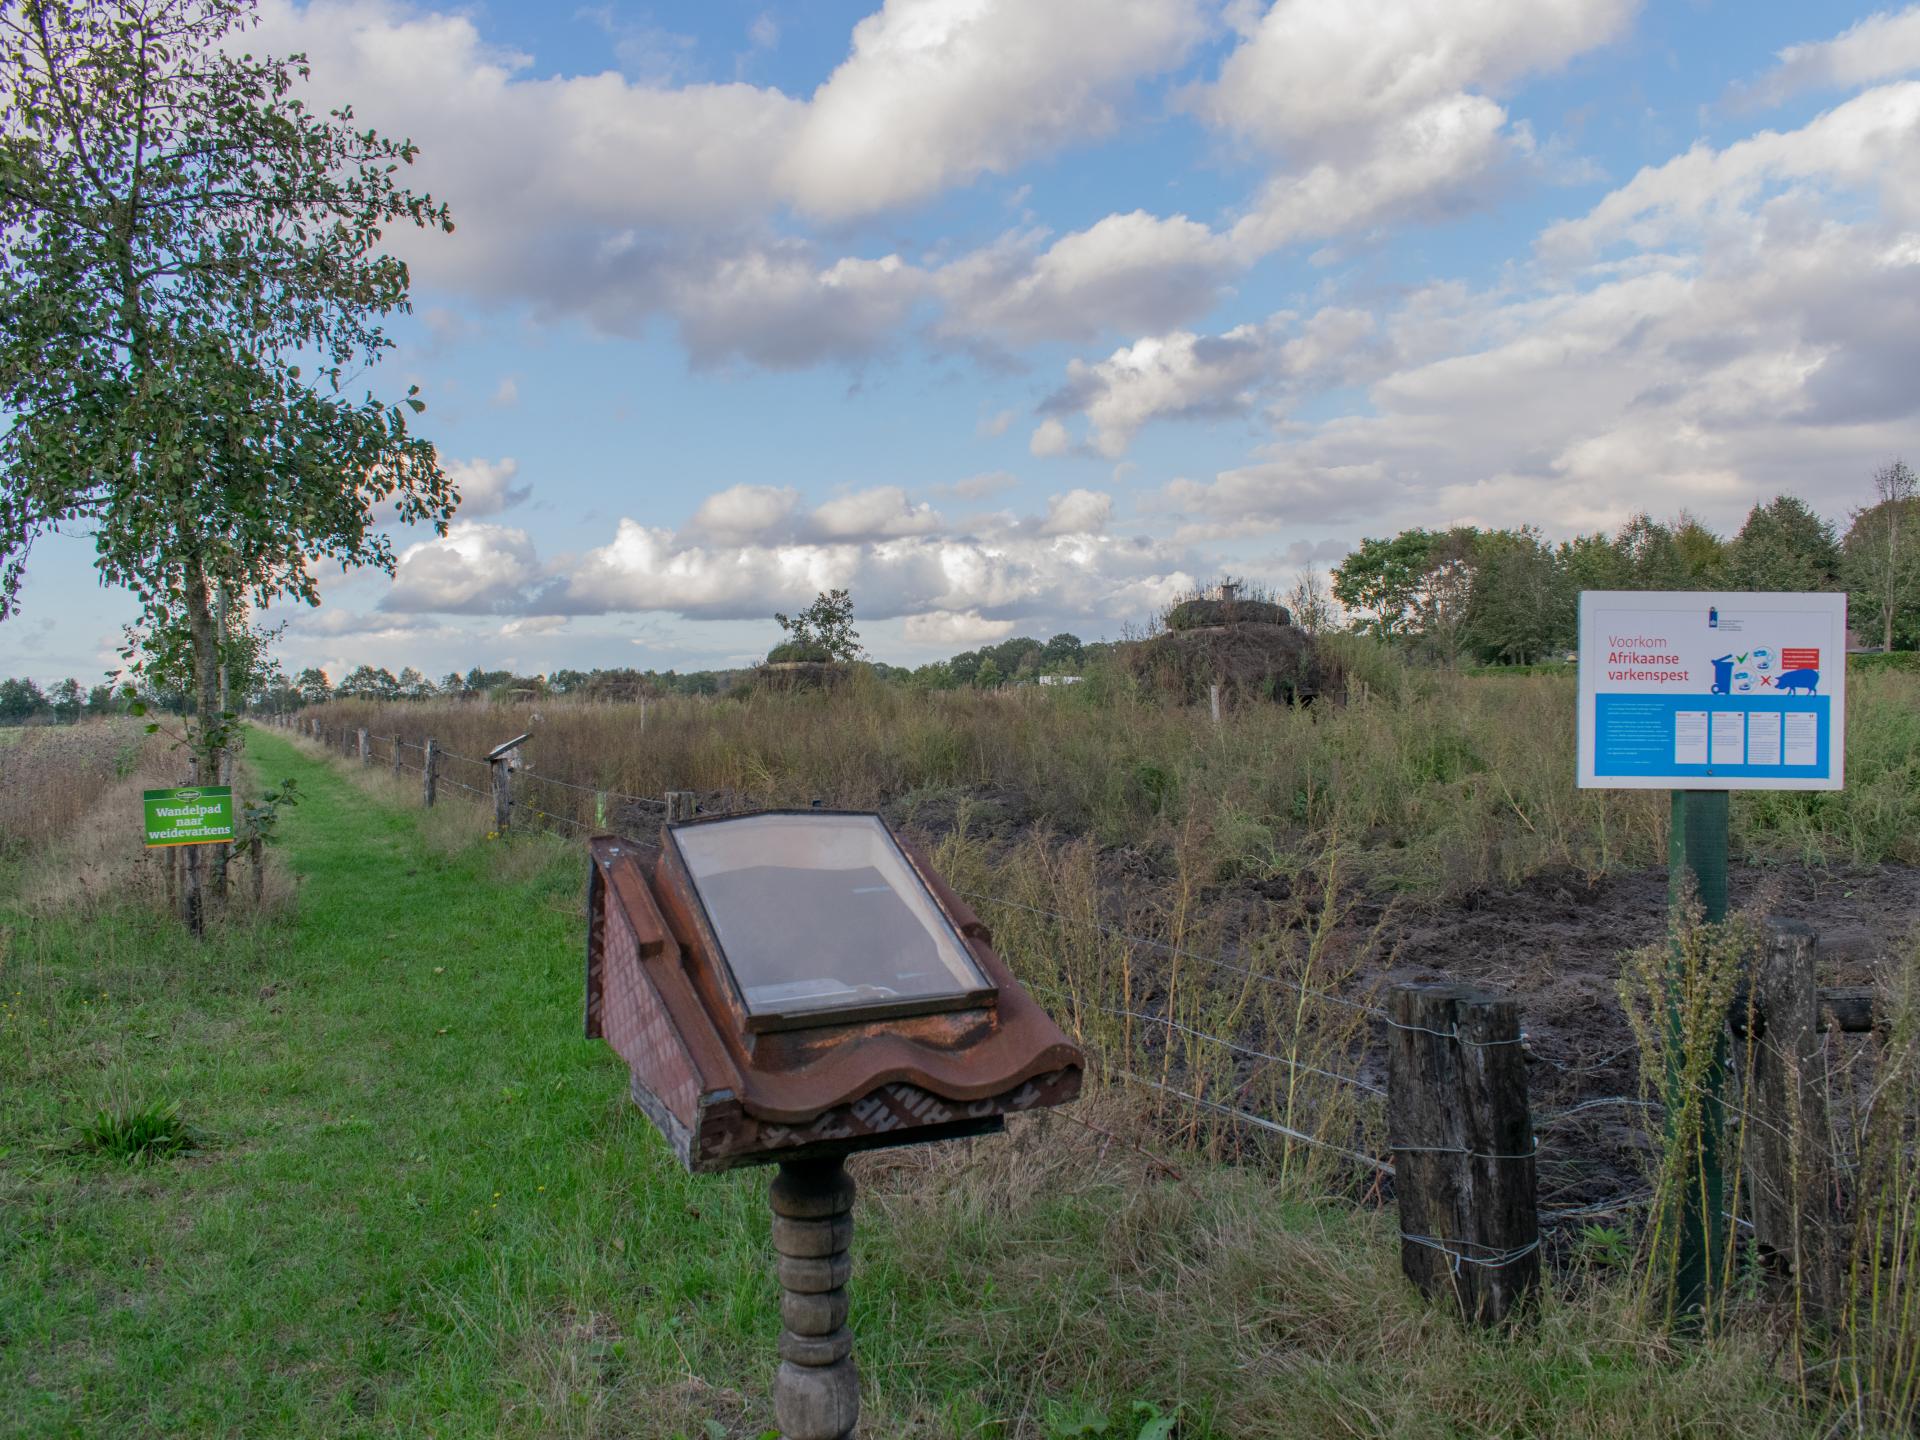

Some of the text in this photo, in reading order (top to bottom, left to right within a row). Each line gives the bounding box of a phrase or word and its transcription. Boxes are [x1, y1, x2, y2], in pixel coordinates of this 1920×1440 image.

[1608, 635, 1667, 648] Voorkom
[1608, 652, 1679, 664] Afrikaanse
[1608, 669, 1689, 684] varkenspest
[156, 804, 221, 817] Wandelpad
[175, 817, 203, 827] naar
[149, 826, 231, 839] weidevarkens
